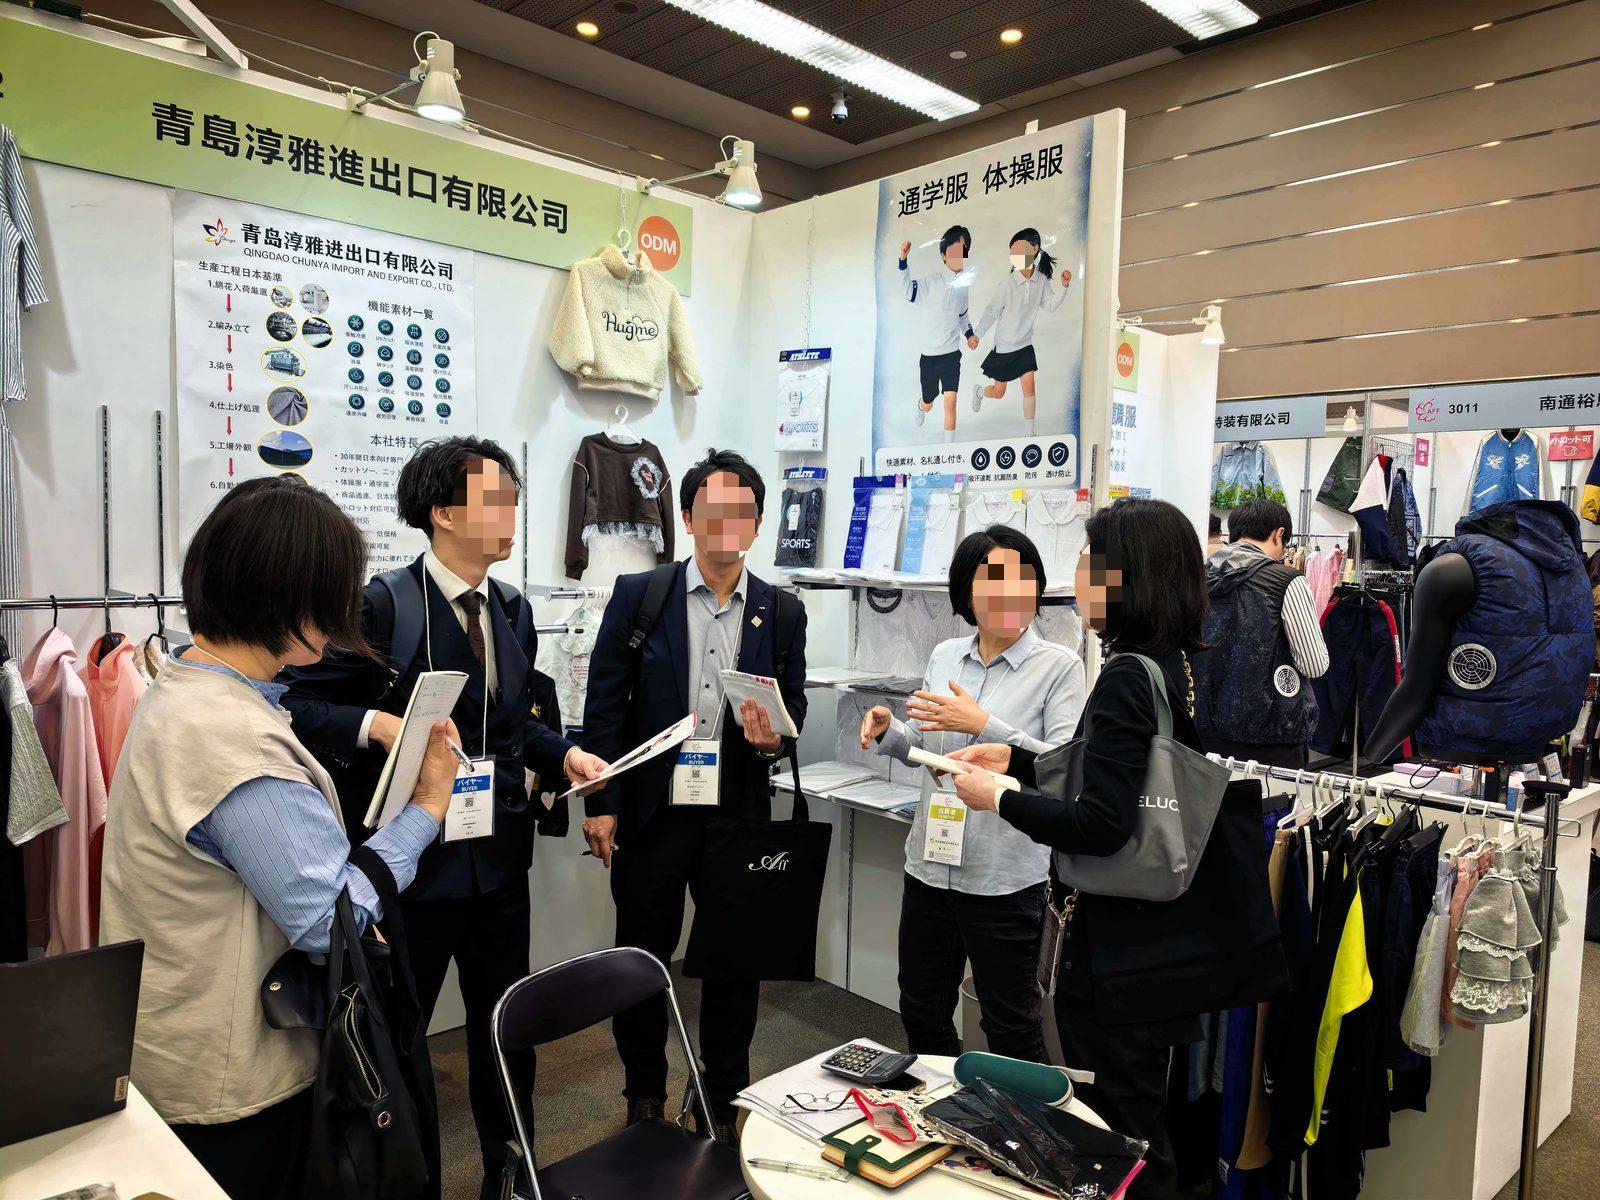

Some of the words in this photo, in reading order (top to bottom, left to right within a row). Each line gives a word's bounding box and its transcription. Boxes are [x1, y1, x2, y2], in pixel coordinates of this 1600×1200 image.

[152, 102, 567, 234] 青島淳雅進出口有限公司
[898, 171, 968, 218] 通学服
[982, 144, 1063, 194] 体操服
[641, 232, 677, 255] ODM
[241, 223, 453, 280] 青岛淳雅进出口有限公司
[198, 260, 283, 282] 生産工程日本基準
[244, 247, 290, 263] QINGDAO
[292, 256, 330, 270] CHUNYA
[331, 263, 366, 276] IMPORT
[367, 270, 386, 280] AND
[387, 274, 419, 286] EXPORT
[438, 283, 455, 293] LTD.
[367, 299, 434, 320] 機能素材一覧
[208, 320, 250, 334] 2.編み立て
[789, 351, 820, 361] ATHLETE
[1117, 354, 1133, 367] ODM
[208, 360, 234, 371] 3.染色
[209, 401, 260, 414] 4.仕上げ処理
[1449, 403, 1478, 414] 3011
[784, 420, 819, 433] SPORTS
[370, 433, 419, 449] 本社特長
[1550, 434, 1592, 445] 小ロット可
[209, 441, 252, 452] 5.工場外観
[788, 471, 815, 479] ATHLETE
[781, 538, 811, 549] SPORTS
[457, 778, 482, 786] バイヤー
